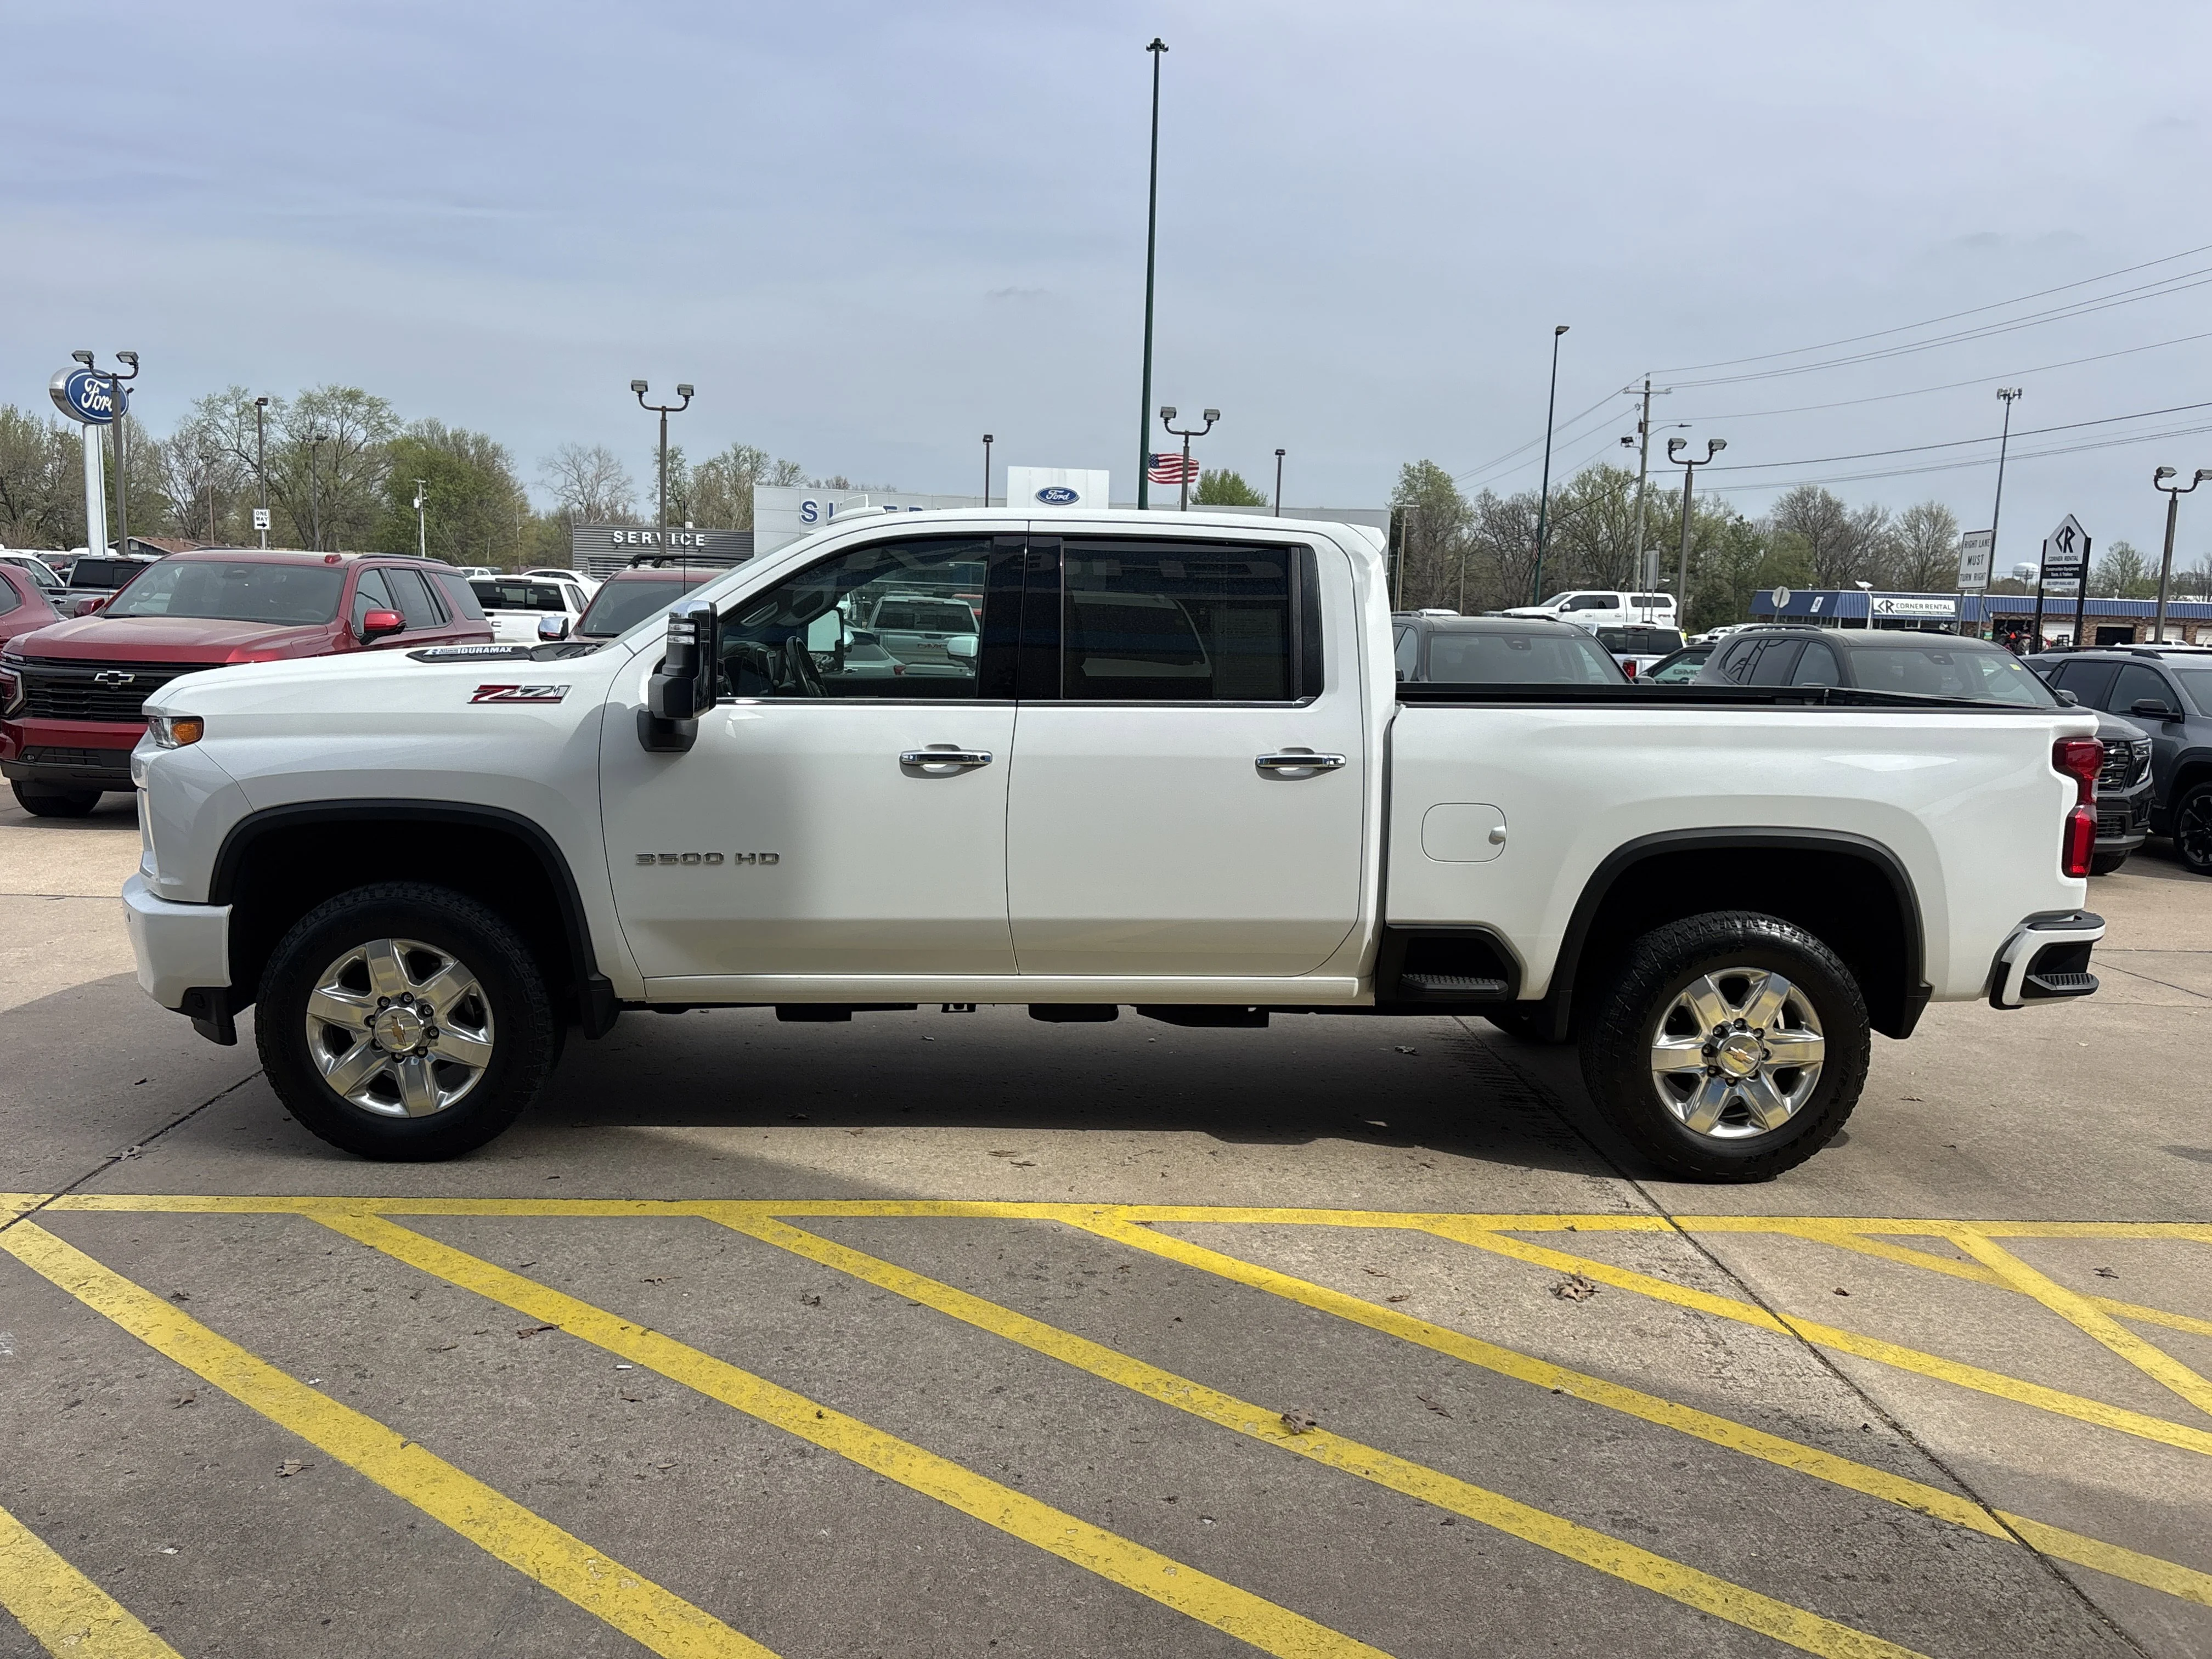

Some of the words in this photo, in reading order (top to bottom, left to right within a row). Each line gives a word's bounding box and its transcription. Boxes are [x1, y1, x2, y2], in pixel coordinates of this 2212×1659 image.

[81, 378, 113, 412] For
[1046, 490, 1070, 500] Ford
[613, 531, 706, 546] SERICE
[1964, 539, 1978, 549] RIGHT
[1978, 538, 1990, 548] LANE
[1967, 554, 1984, 566] MUST
[1960, 573, 1972, 582] TURN
[1974, 572, 1986, 580] RIGHT
[466, 685, 572, 704] Z71
[636, 851, 725, 866] 3500
[735, 852, 780, 866] HD
